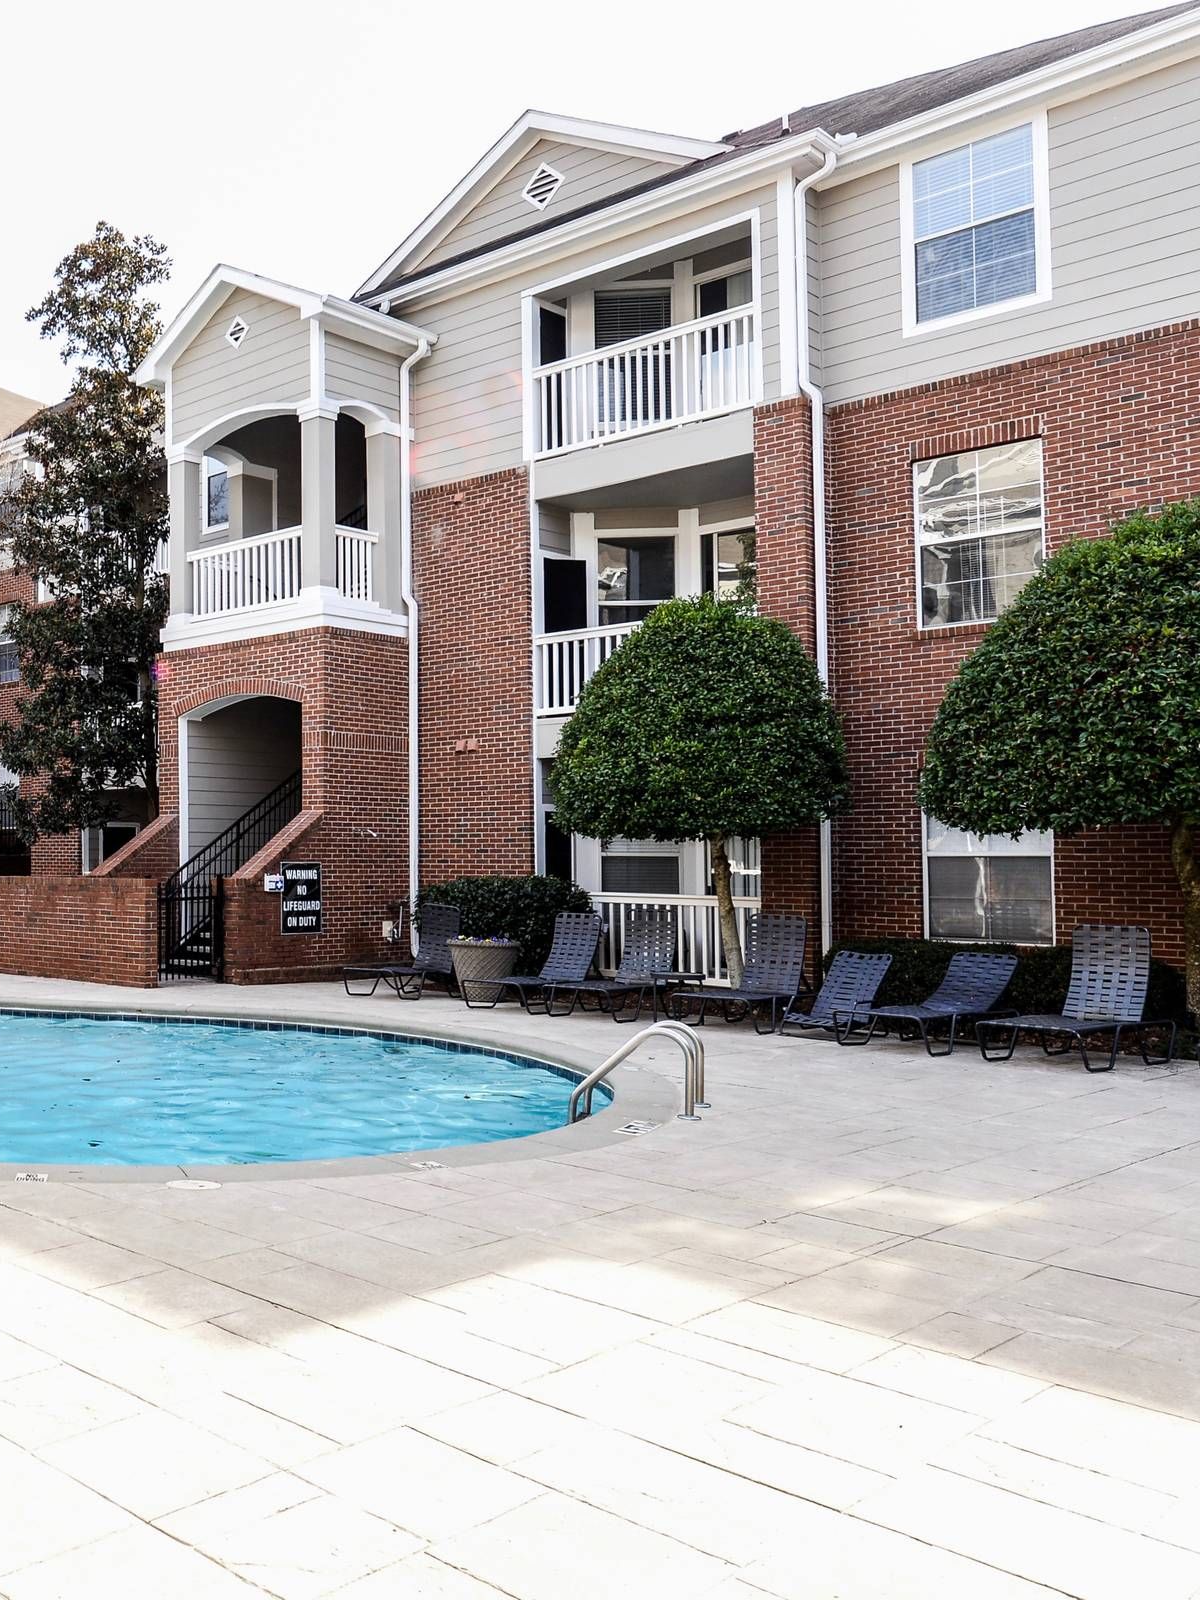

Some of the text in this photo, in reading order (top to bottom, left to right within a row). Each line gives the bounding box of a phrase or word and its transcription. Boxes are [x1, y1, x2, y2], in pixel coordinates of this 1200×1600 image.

[286, 869, 318, 880] WARNING
[297, 885, 307, 895] NO
[283, 901, 320, 911] LIFEGUARD
[287, 916, 317, 927] ON DUTY
